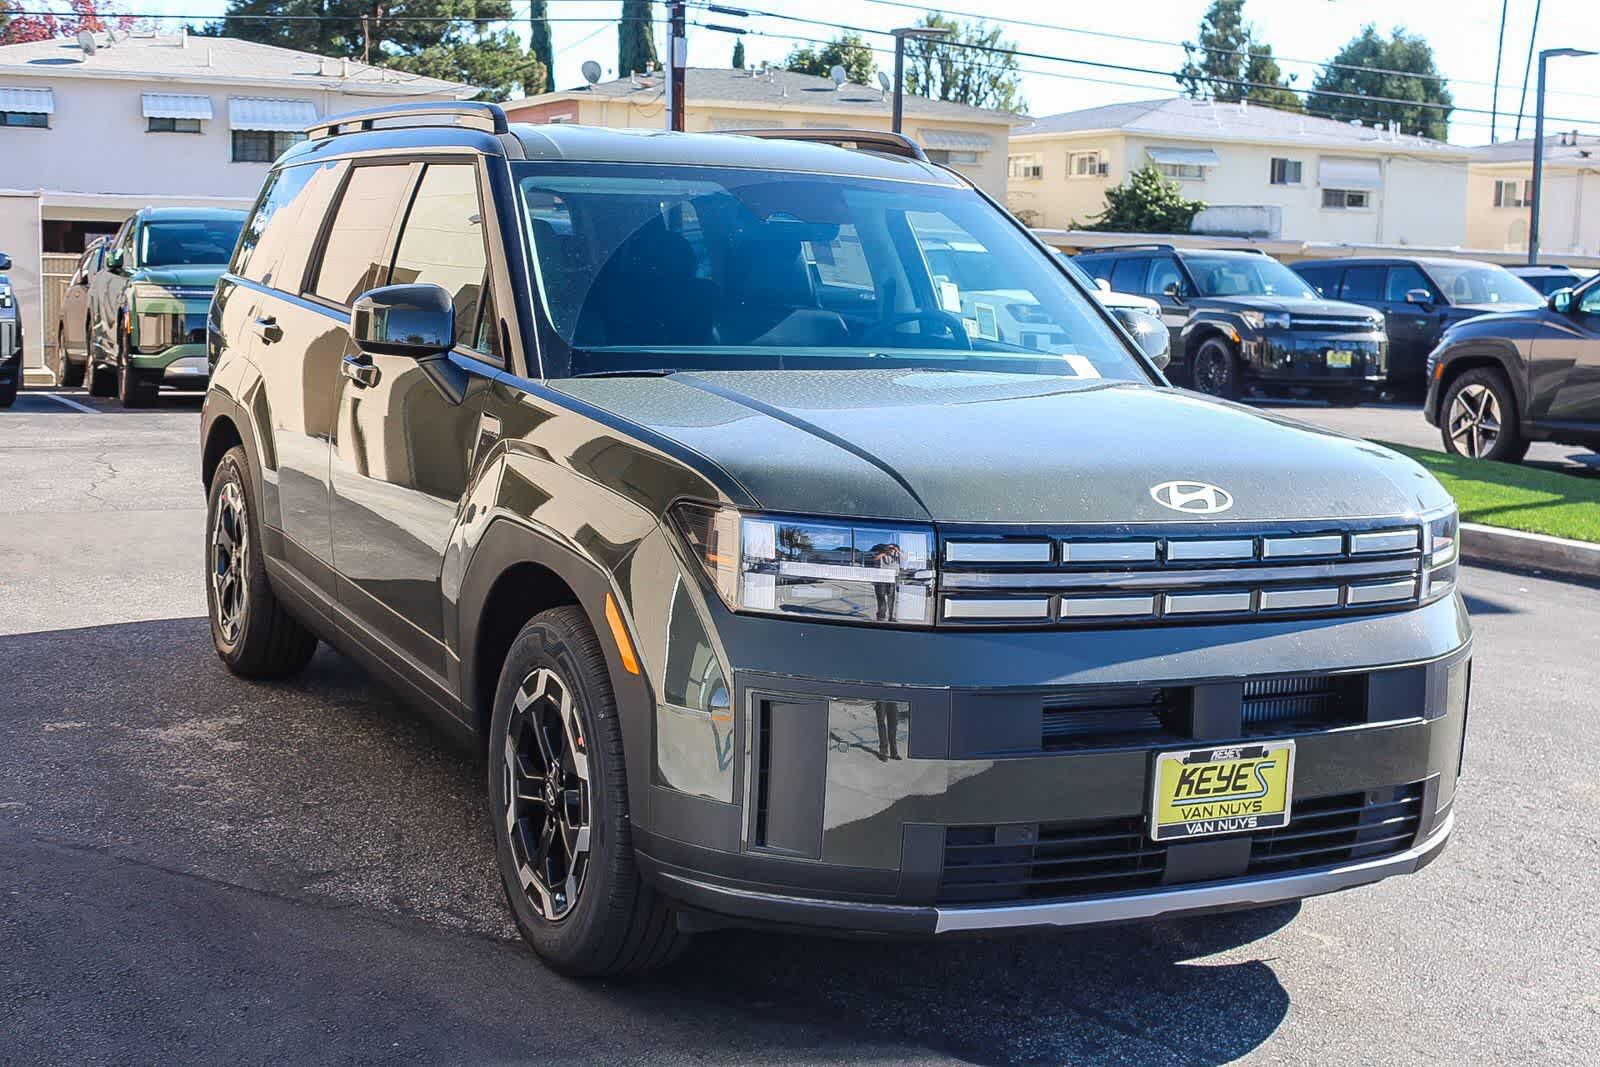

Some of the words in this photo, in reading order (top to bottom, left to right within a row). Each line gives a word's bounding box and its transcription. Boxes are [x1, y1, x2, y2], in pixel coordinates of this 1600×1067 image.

[1174, 760, 1276, 799] KEYES
[1181, 805, 1213, 820] VAN
[1218, 800, 1262, 815] NUYS
[1186, 822, 1215, 835] VAN
[1218, 817, 1258, 832] NUYS
